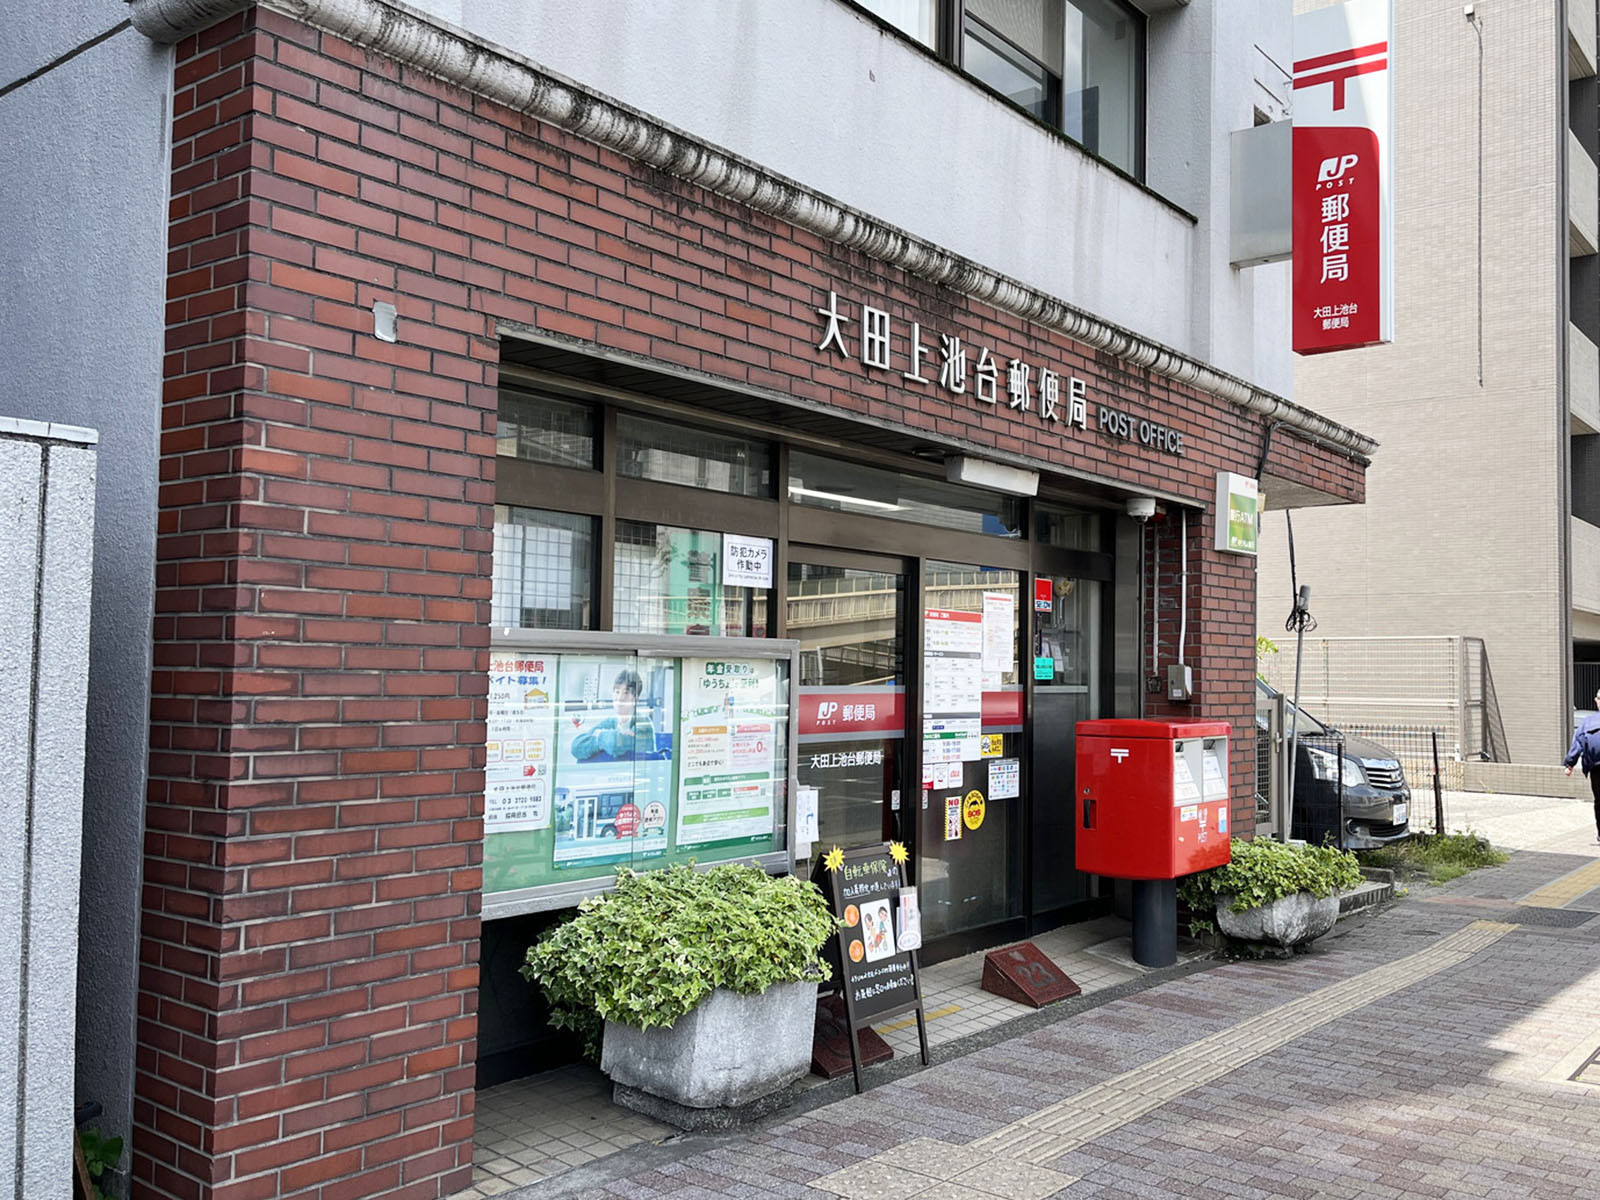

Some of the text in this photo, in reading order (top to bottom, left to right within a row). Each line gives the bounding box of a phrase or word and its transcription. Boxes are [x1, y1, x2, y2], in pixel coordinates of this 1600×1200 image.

[1316, 177, 1355, 191] POST
[1320, 193, 1350, 284] 郵便局
[1313, 302, 1358, 320] 大田上池台
[1322, 317, 1350, 330] 郵便局
[817, 291, 1087, 431] 大田上池台郵便局
[1098, 406, 1184, 454] POST OFFICE
[730, 545, 767, 560] 防犯カメラ
[737, 560, 761, 571] 作動中
[842, 704, 876, 721] 郵便局
[810, 751, 882, 769] 大田上池台郵便局
